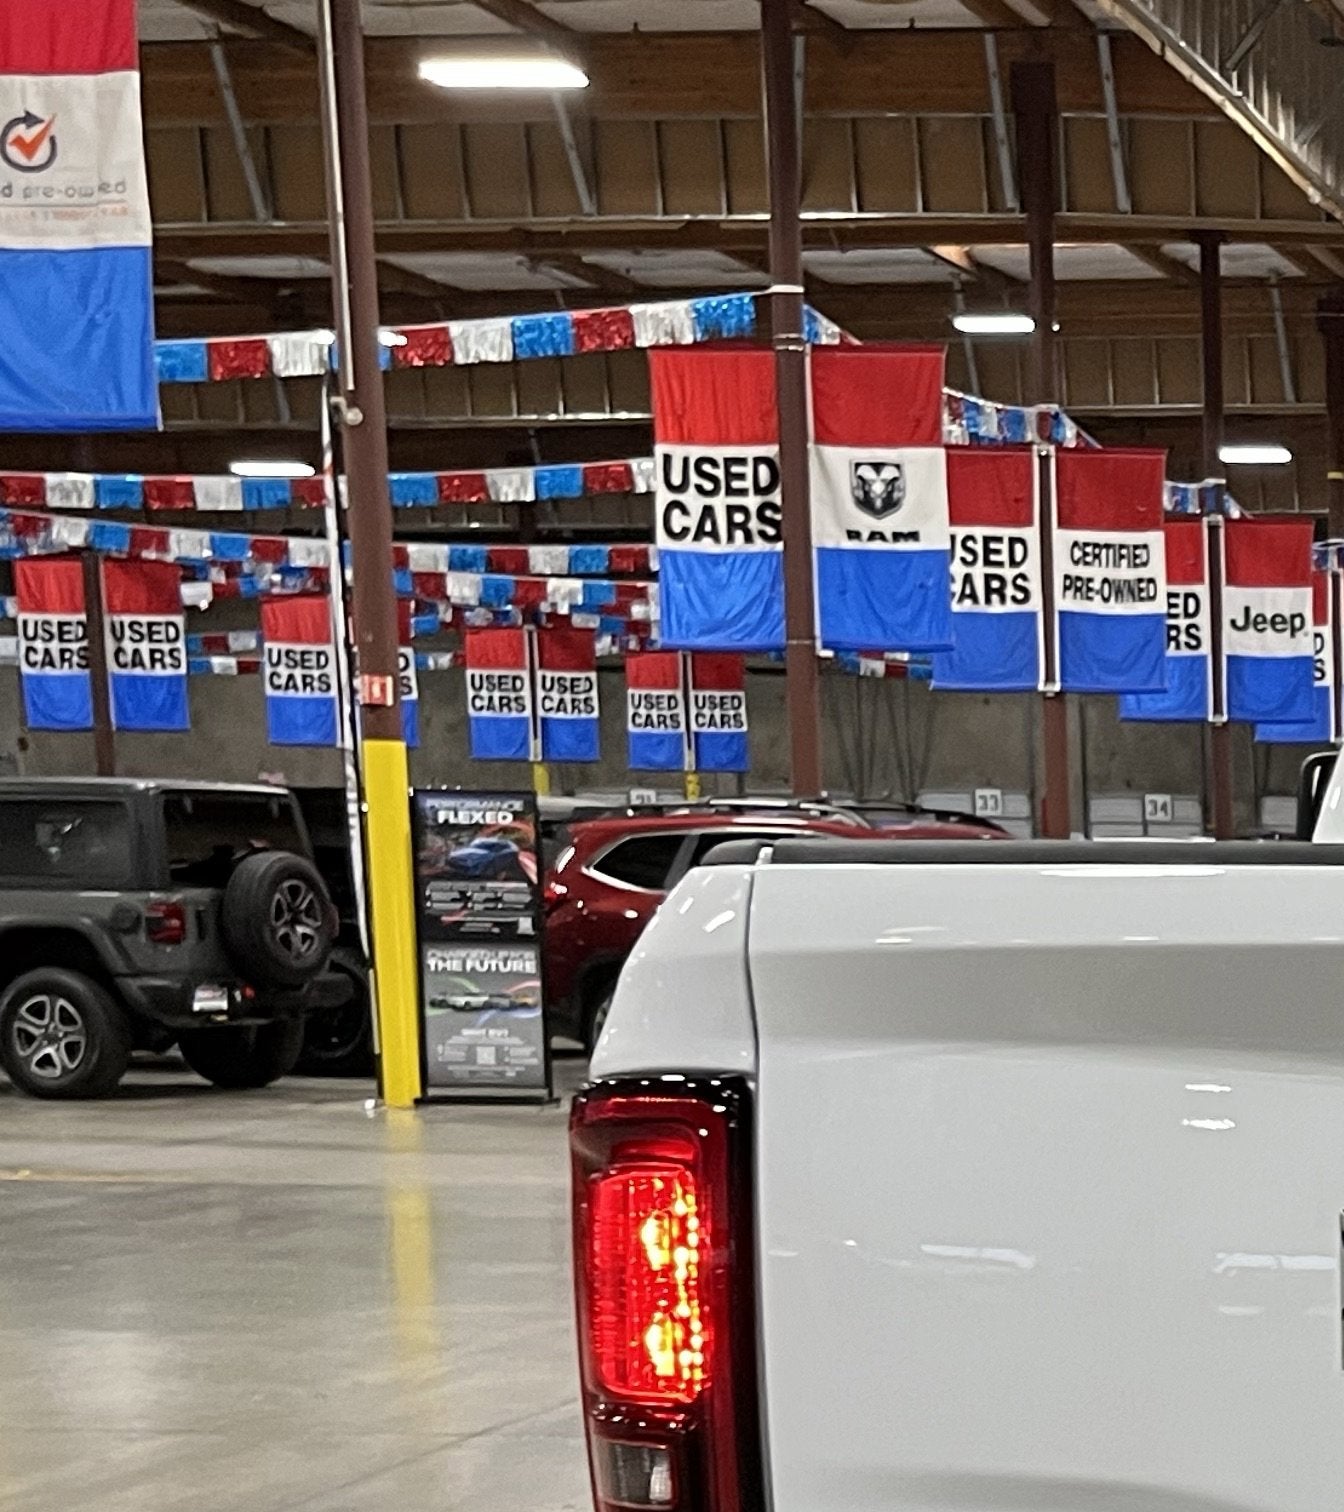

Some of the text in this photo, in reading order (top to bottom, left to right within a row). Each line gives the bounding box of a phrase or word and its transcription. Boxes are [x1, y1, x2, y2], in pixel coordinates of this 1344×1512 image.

[661, 453, 781, 498] USED
[661, 499, 784, 545] CARS
[846, 529, 921, 543] RAM
[1069, 540, 1151, 570] CERTIFIED
[1062, 573, 1158, 604] PRE-OWNED
[1167, 592, 1201, 620] ED
[21, 619, 87, 643] USED
[110, 619, 181, 643] USED
[1230, 605, 1306, 639] Jeep
[1167, 623, 1202, 652] RS
[24, 646, 89, 670] CARS
[113, 646, 182, 670] CARS
[267, 649, 330, 670] USED
[268, 672, 332, 693] CARS
[470, 673, 525, 693] USED
[541, 675, 593, 694] USED
[471, 694, 526, 714] CARS
[541, 695, 595, 715] CARS
[630, 692, 679, 711] USED
[694, 693, 742, 711] USED
[630, 712, 681, 730] CARS
[694, 712, 744, 731] CARS
[437, 810, 514, 825] FLEXED
[427, 959, 536, 974] THE FUTURE
